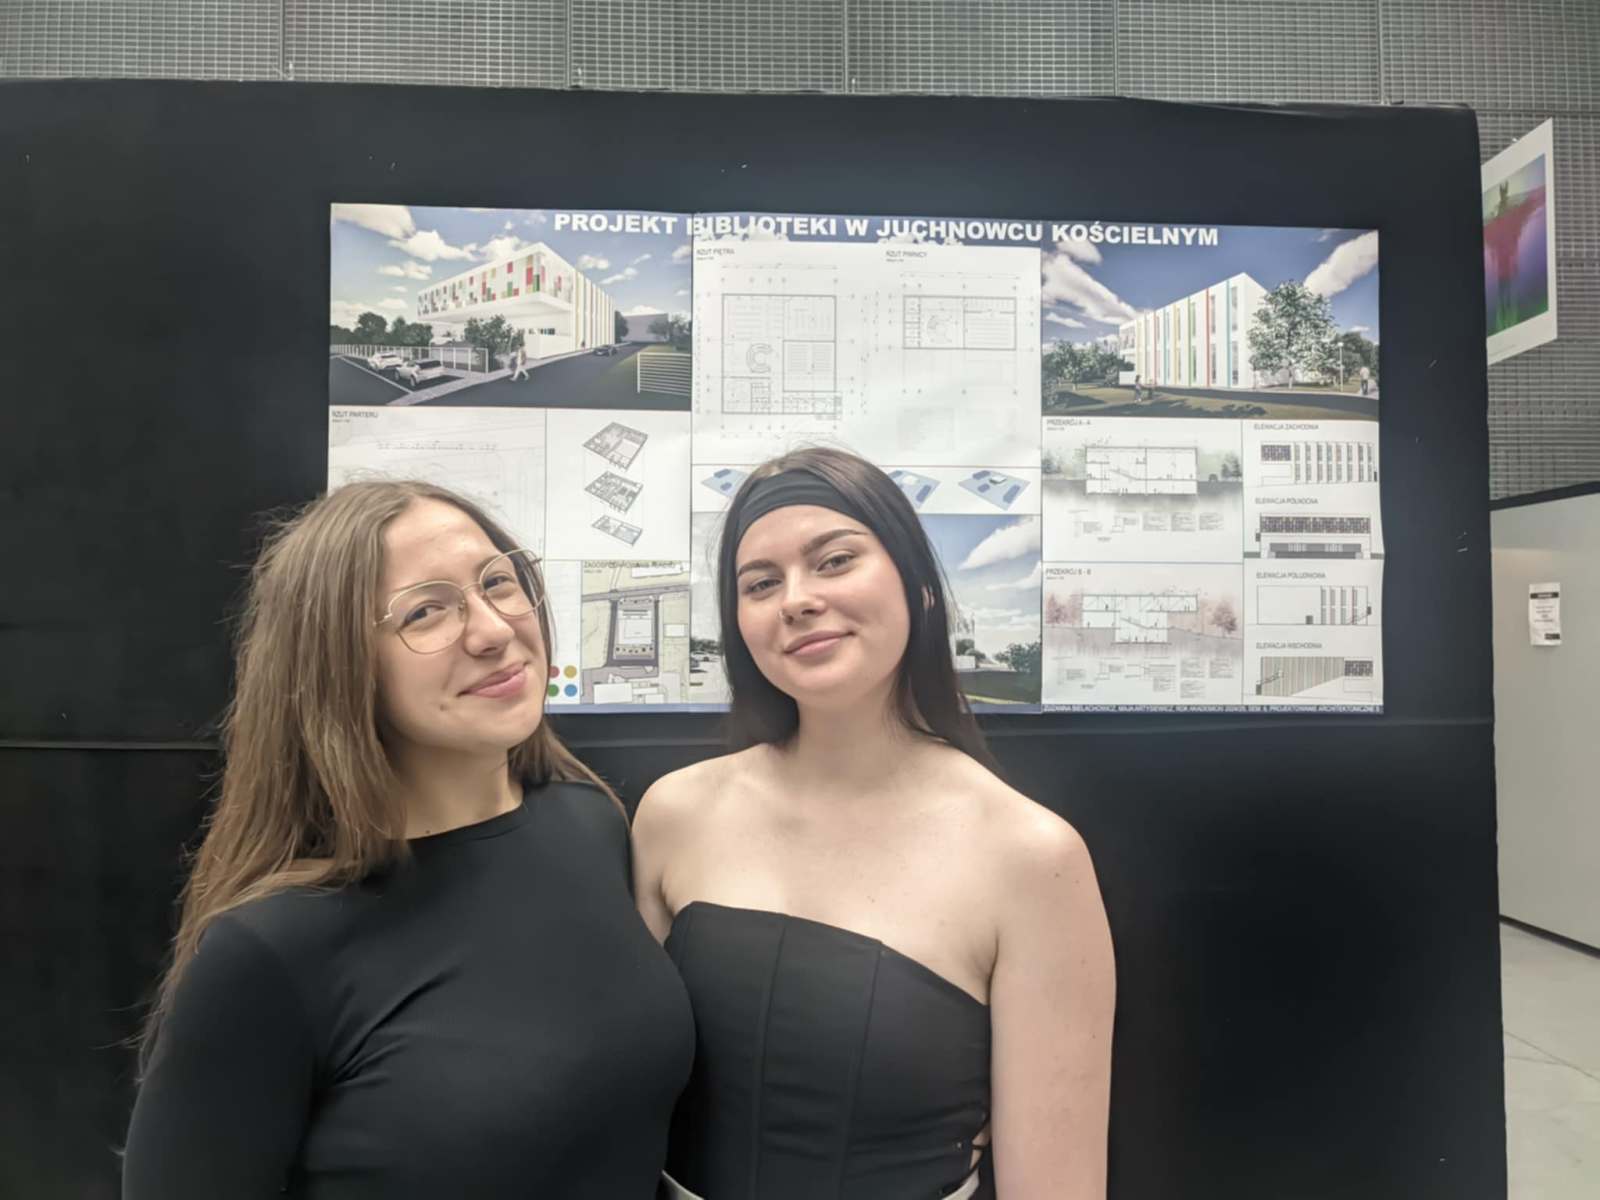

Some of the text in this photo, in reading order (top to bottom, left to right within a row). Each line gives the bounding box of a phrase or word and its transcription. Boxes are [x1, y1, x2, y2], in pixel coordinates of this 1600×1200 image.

[554, 213, 1219, 246] PROJEKT BIBLIOTEKI W JUCHNOWCU KOŚCIELNYM
